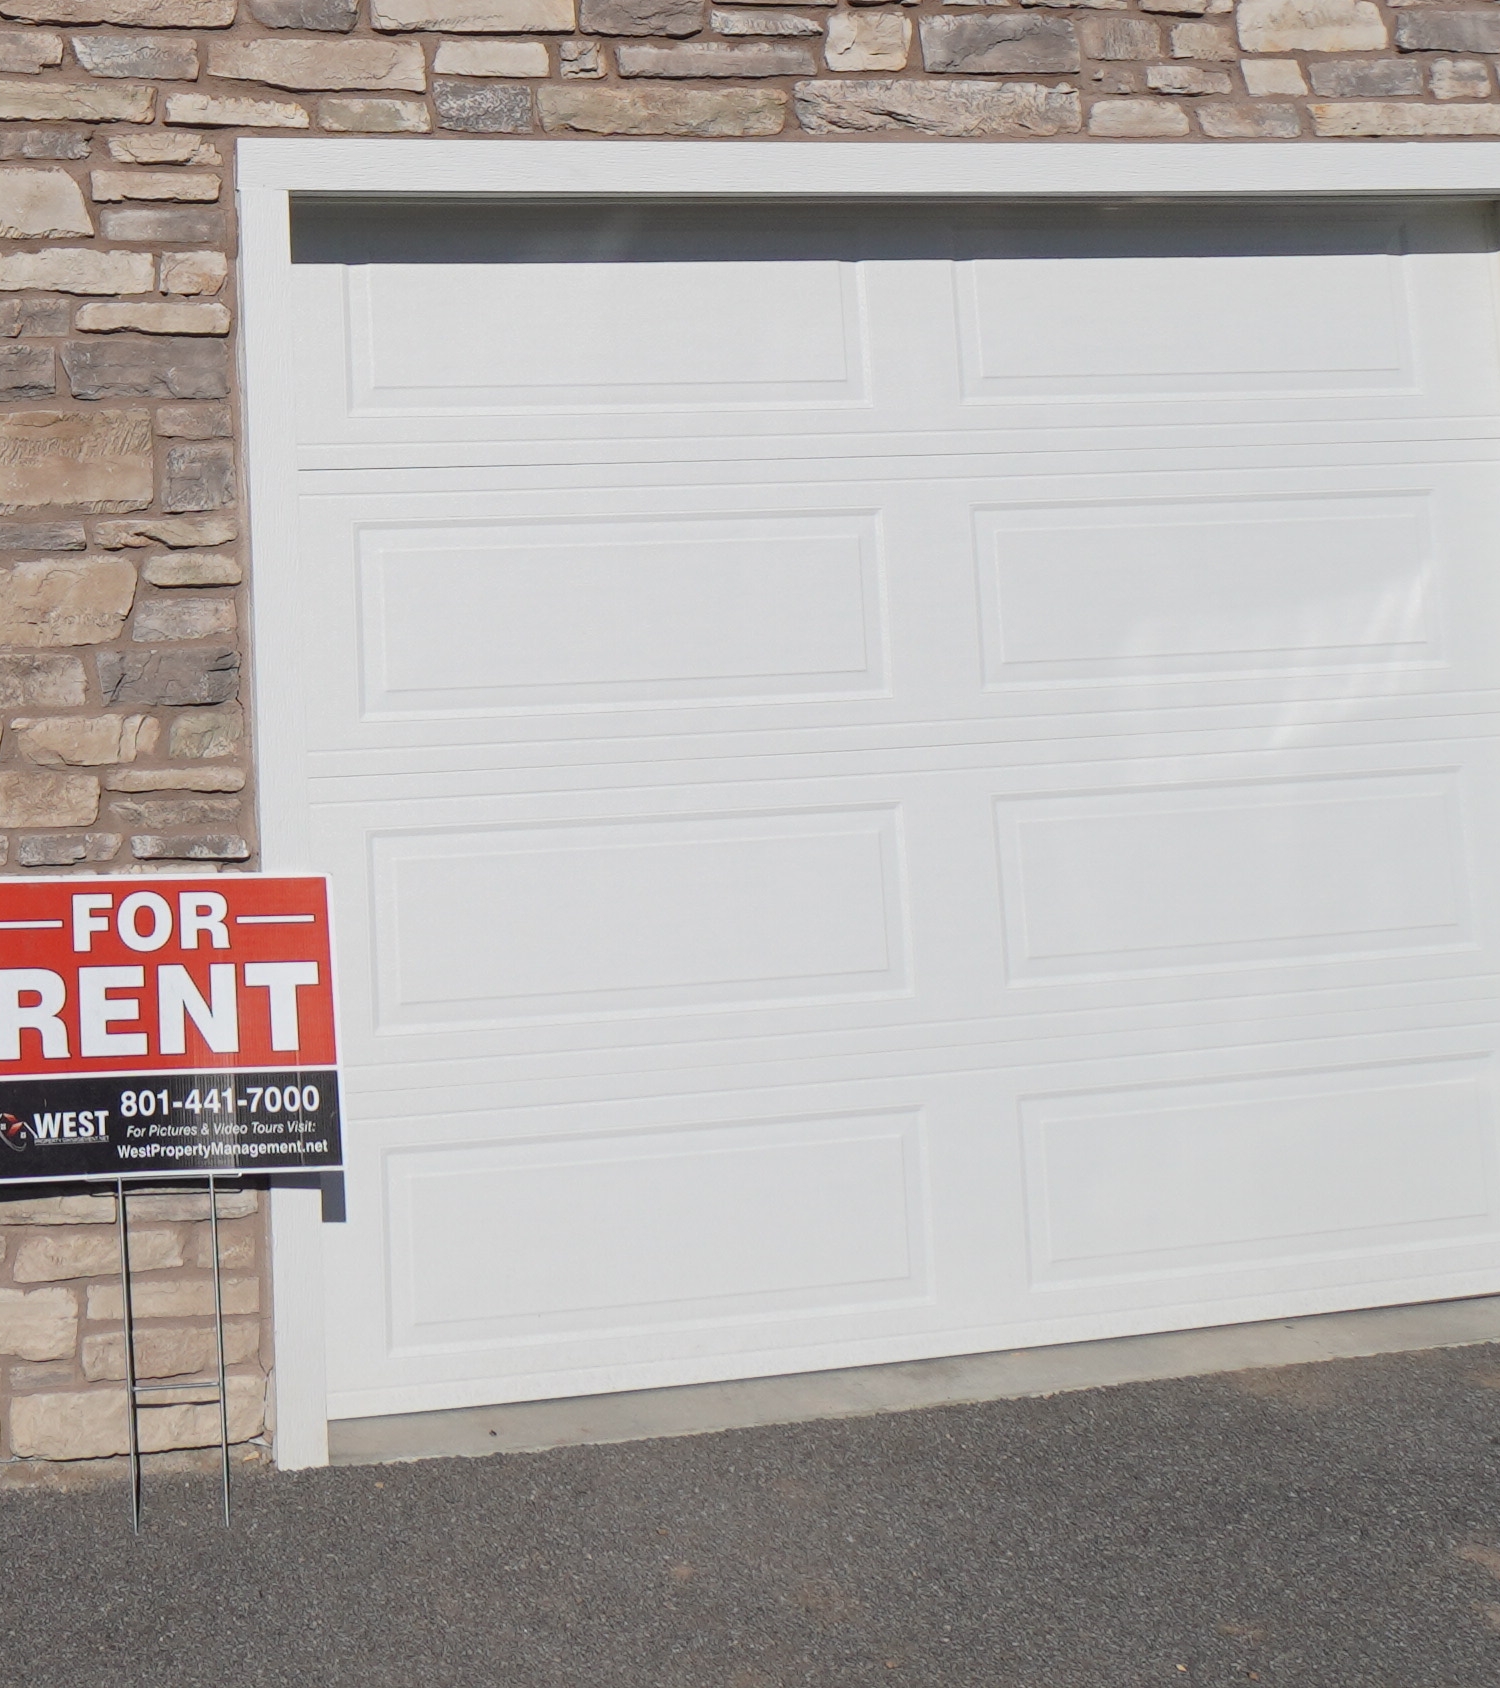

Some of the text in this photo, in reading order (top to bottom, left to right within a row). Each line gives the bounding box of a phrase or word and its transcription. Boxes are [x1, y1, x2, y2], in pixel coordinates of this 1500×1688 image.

[72, 890, 232, 953] FOR
[120, 1085, 320, 1117] 801-441-7000
[33, 1110, 109, 1139] WEST
[126, 1120, 316, 1138] For Pictures & Video Tours Visit:
[116, 1139, 329, 1159] WestPropertyManagement.net
